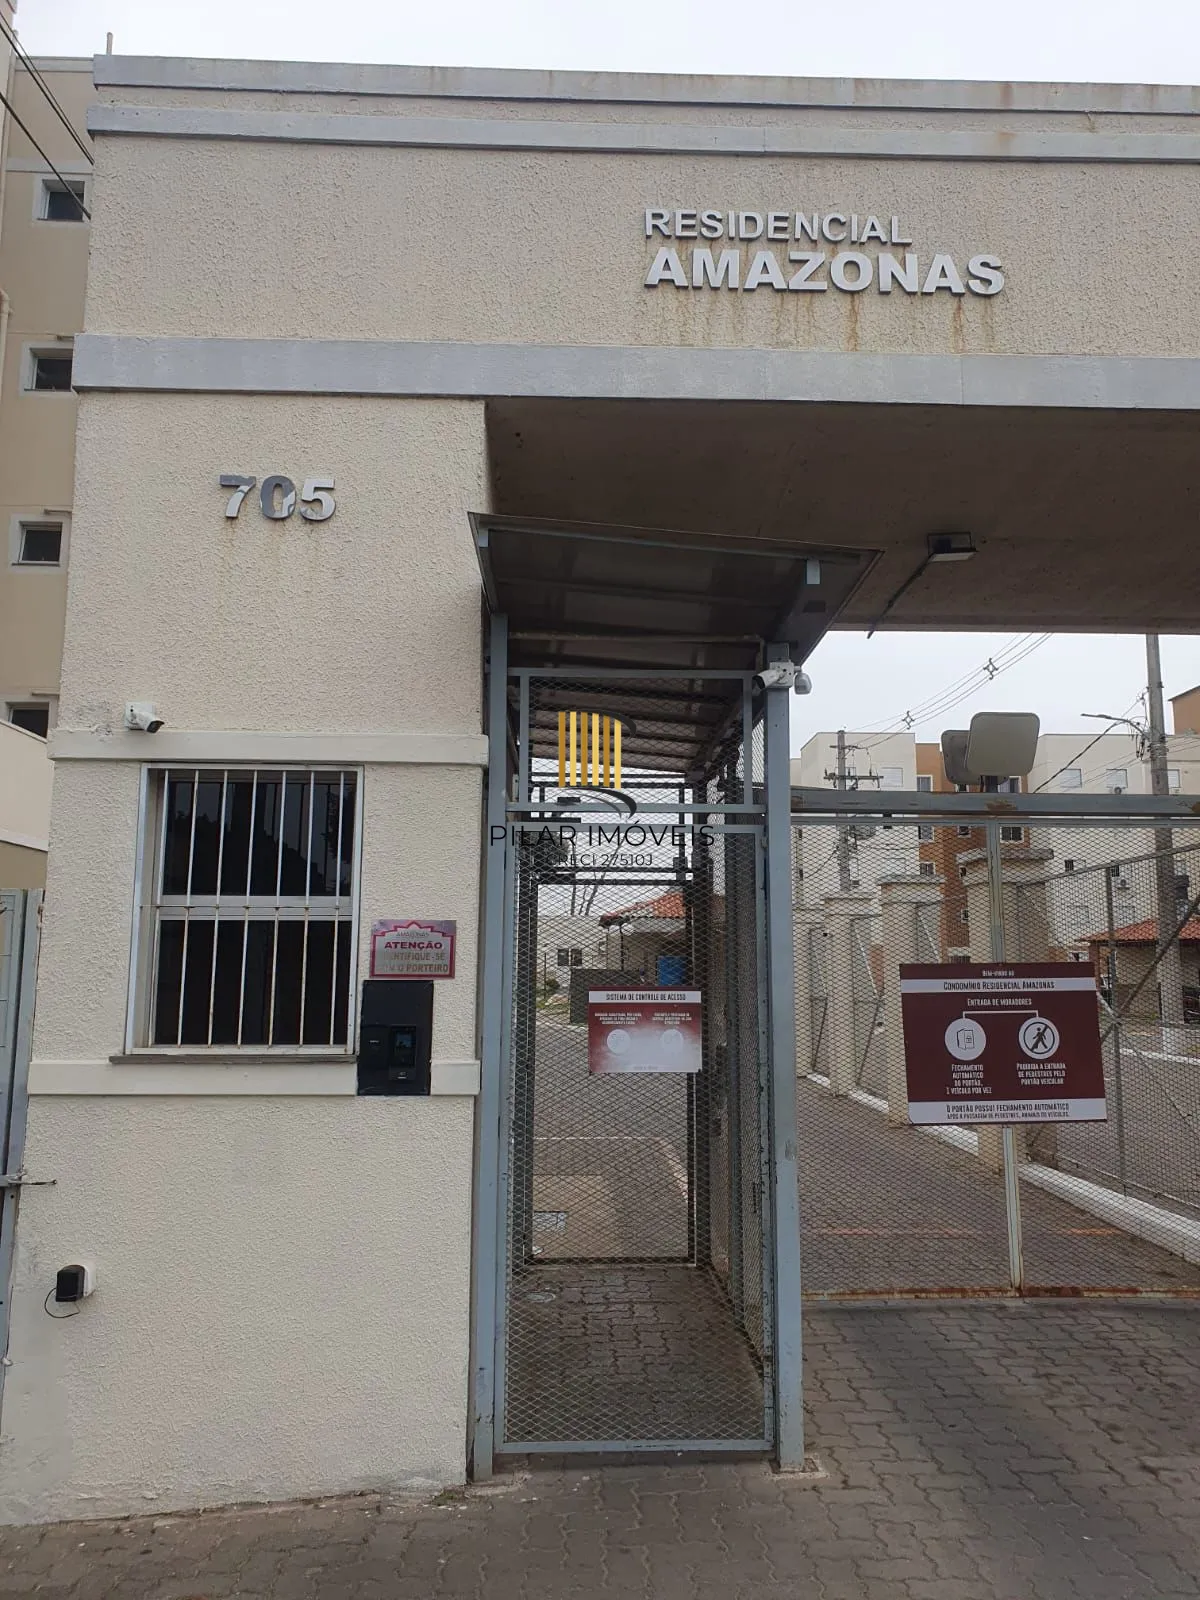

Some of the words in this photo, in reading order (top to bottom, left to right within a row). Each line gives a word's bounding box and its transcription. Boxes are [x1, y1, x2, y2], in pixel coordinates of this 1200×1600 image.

[644, 208, 912, 245] RESIDENCIAL
[644, 247, 1006, 296] AMAZONAS
[219, 474, 336, 521] 705
[384, 941, 443, 951] ATENÇÃO
[406, 964, 449, 973] PORTEIRO
[943, 980, 981, 991] CONDOMÍNIO
[982, 981, 1021, 990] RESIDENCIAL
[1022, 980, 1055, 990] AMAZONAS
[606, 993, 627, 1001] SISTEMA
[628, 993, 634, 1001] DE
[635, 993, 660, 1001] CONTROLE
[661, 993, 667, 1001] DE
[668, 993, 686, 1001] ACESSO
[967, 998, 992, 1006] ENTRADA
[993, 998, 999, 1006] DE
[1000, 998, 1032, 1006] MORADORES
[952, 1071, 984, 1079] AUTOMÁTICO
[1018, 1070, 1025, 1078] DE
[1021, 1077, 1040, 1085] PORTÃO
[951, 1087, 971, 1095] VEÍCULO
[982, 1086, 992, 1094] VEZ
[946, 1105, 951, 1113] O
[951, 1104, 974, 1113] PORTÃO
[974, 1104, 995, 1112] POSSUI
[996, 1104, 1033, 1112] FECHAMENTO
